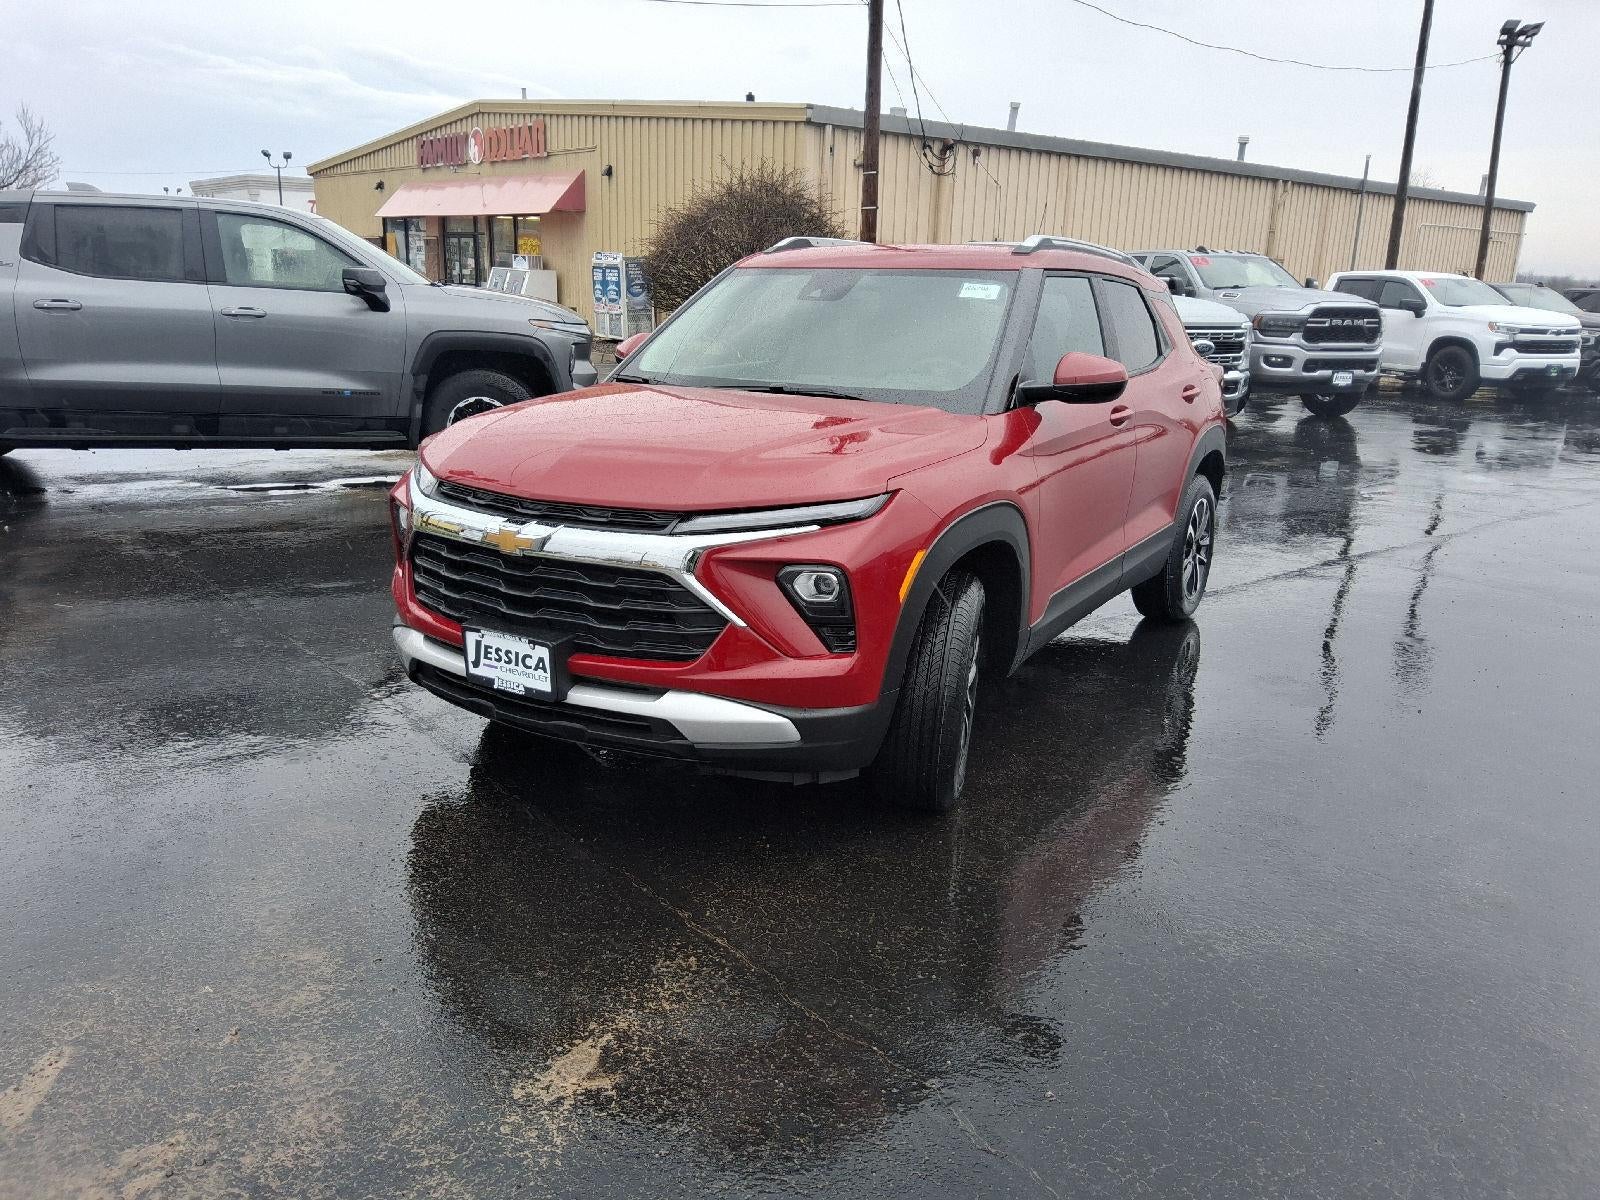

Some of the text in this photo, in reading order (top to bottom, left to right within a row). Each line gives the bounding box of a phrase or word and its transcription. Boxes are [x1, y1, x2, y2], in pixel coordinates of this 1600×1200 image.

[416, 119, 545, 168] FAMILY DOLLAR
[471, 639, 548, 674] JESSICA
[500, 665, 549, 683] CHEVROLET
